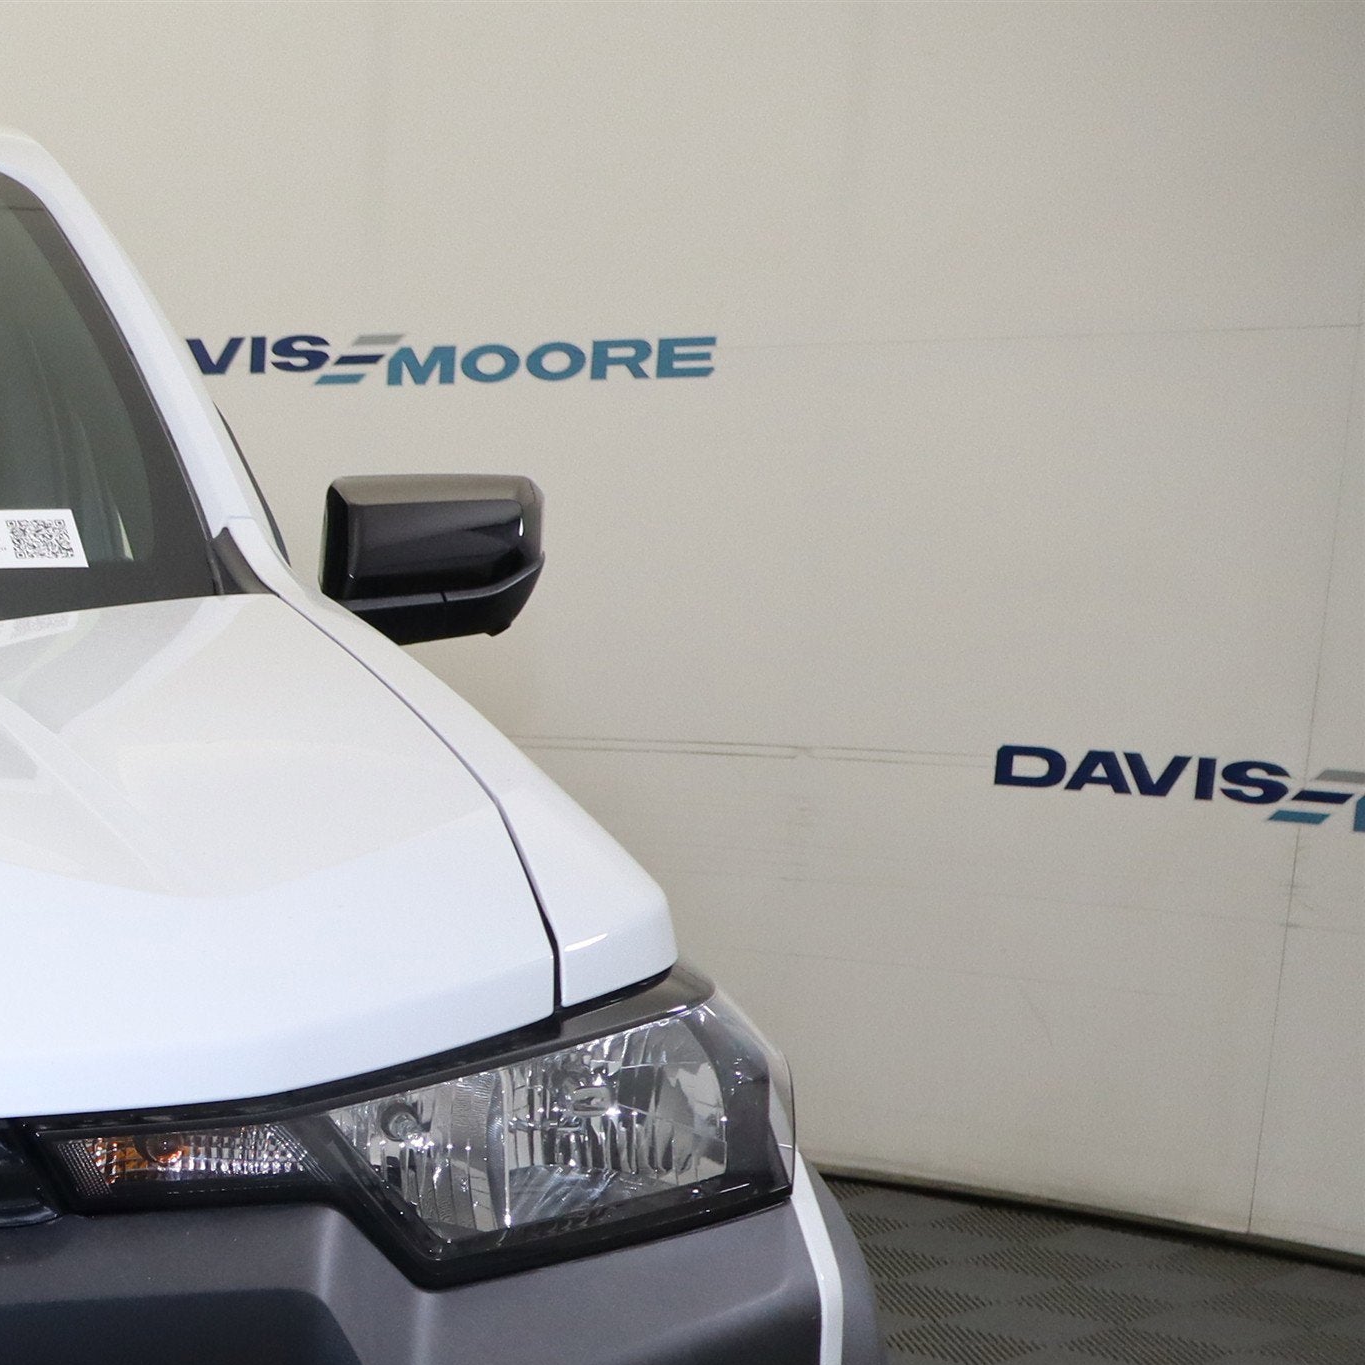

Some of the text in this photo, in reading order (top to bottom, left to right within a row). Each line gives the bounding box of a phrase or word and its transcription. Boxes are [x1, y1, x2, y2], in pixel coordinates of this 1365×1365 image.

[185, 334, 717, 386] VIS MOORE
[994, 745, 1291, 805] DAVIS
